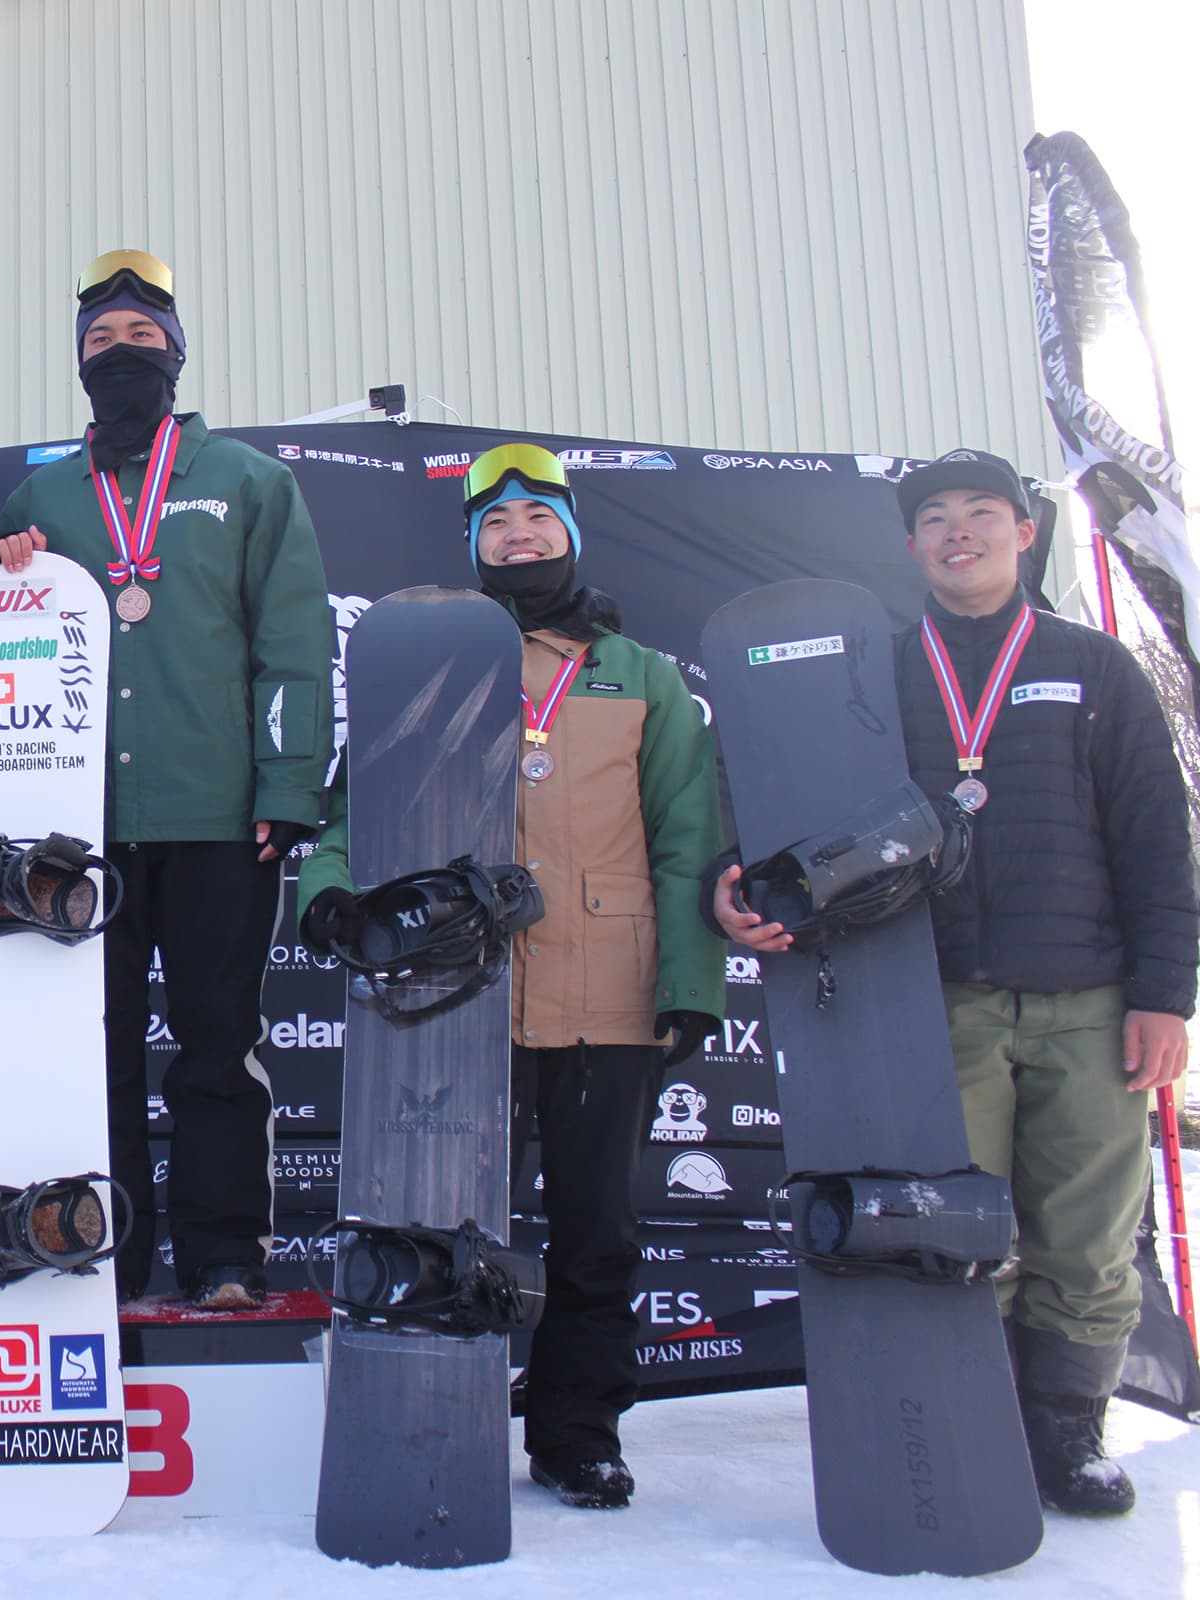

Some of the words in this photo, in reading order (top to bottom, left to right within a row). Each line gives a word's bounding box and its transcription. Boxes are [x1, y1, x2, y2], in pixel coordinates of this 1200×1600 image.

[423, 453, 470, 468] WORLD
[729, 456, 774, 469] PSA
[778, 458, 833, 472] ASIA
[159, 498, 229, 523] THRASHER
[15, 741, 56, 756] RACING
[54, 755, 86, 769] TEAM
[704, 1055, 739, 1063] BINDING
[650, 1129, 707, 1142] HOLIDAY
[273, 1167, 334, 1178] GOODS
[666, 1191, 702, 1199] Mountain
[704, 1192, 726, 1201] Slope
[689, 1337, 744, 1360] RISES
